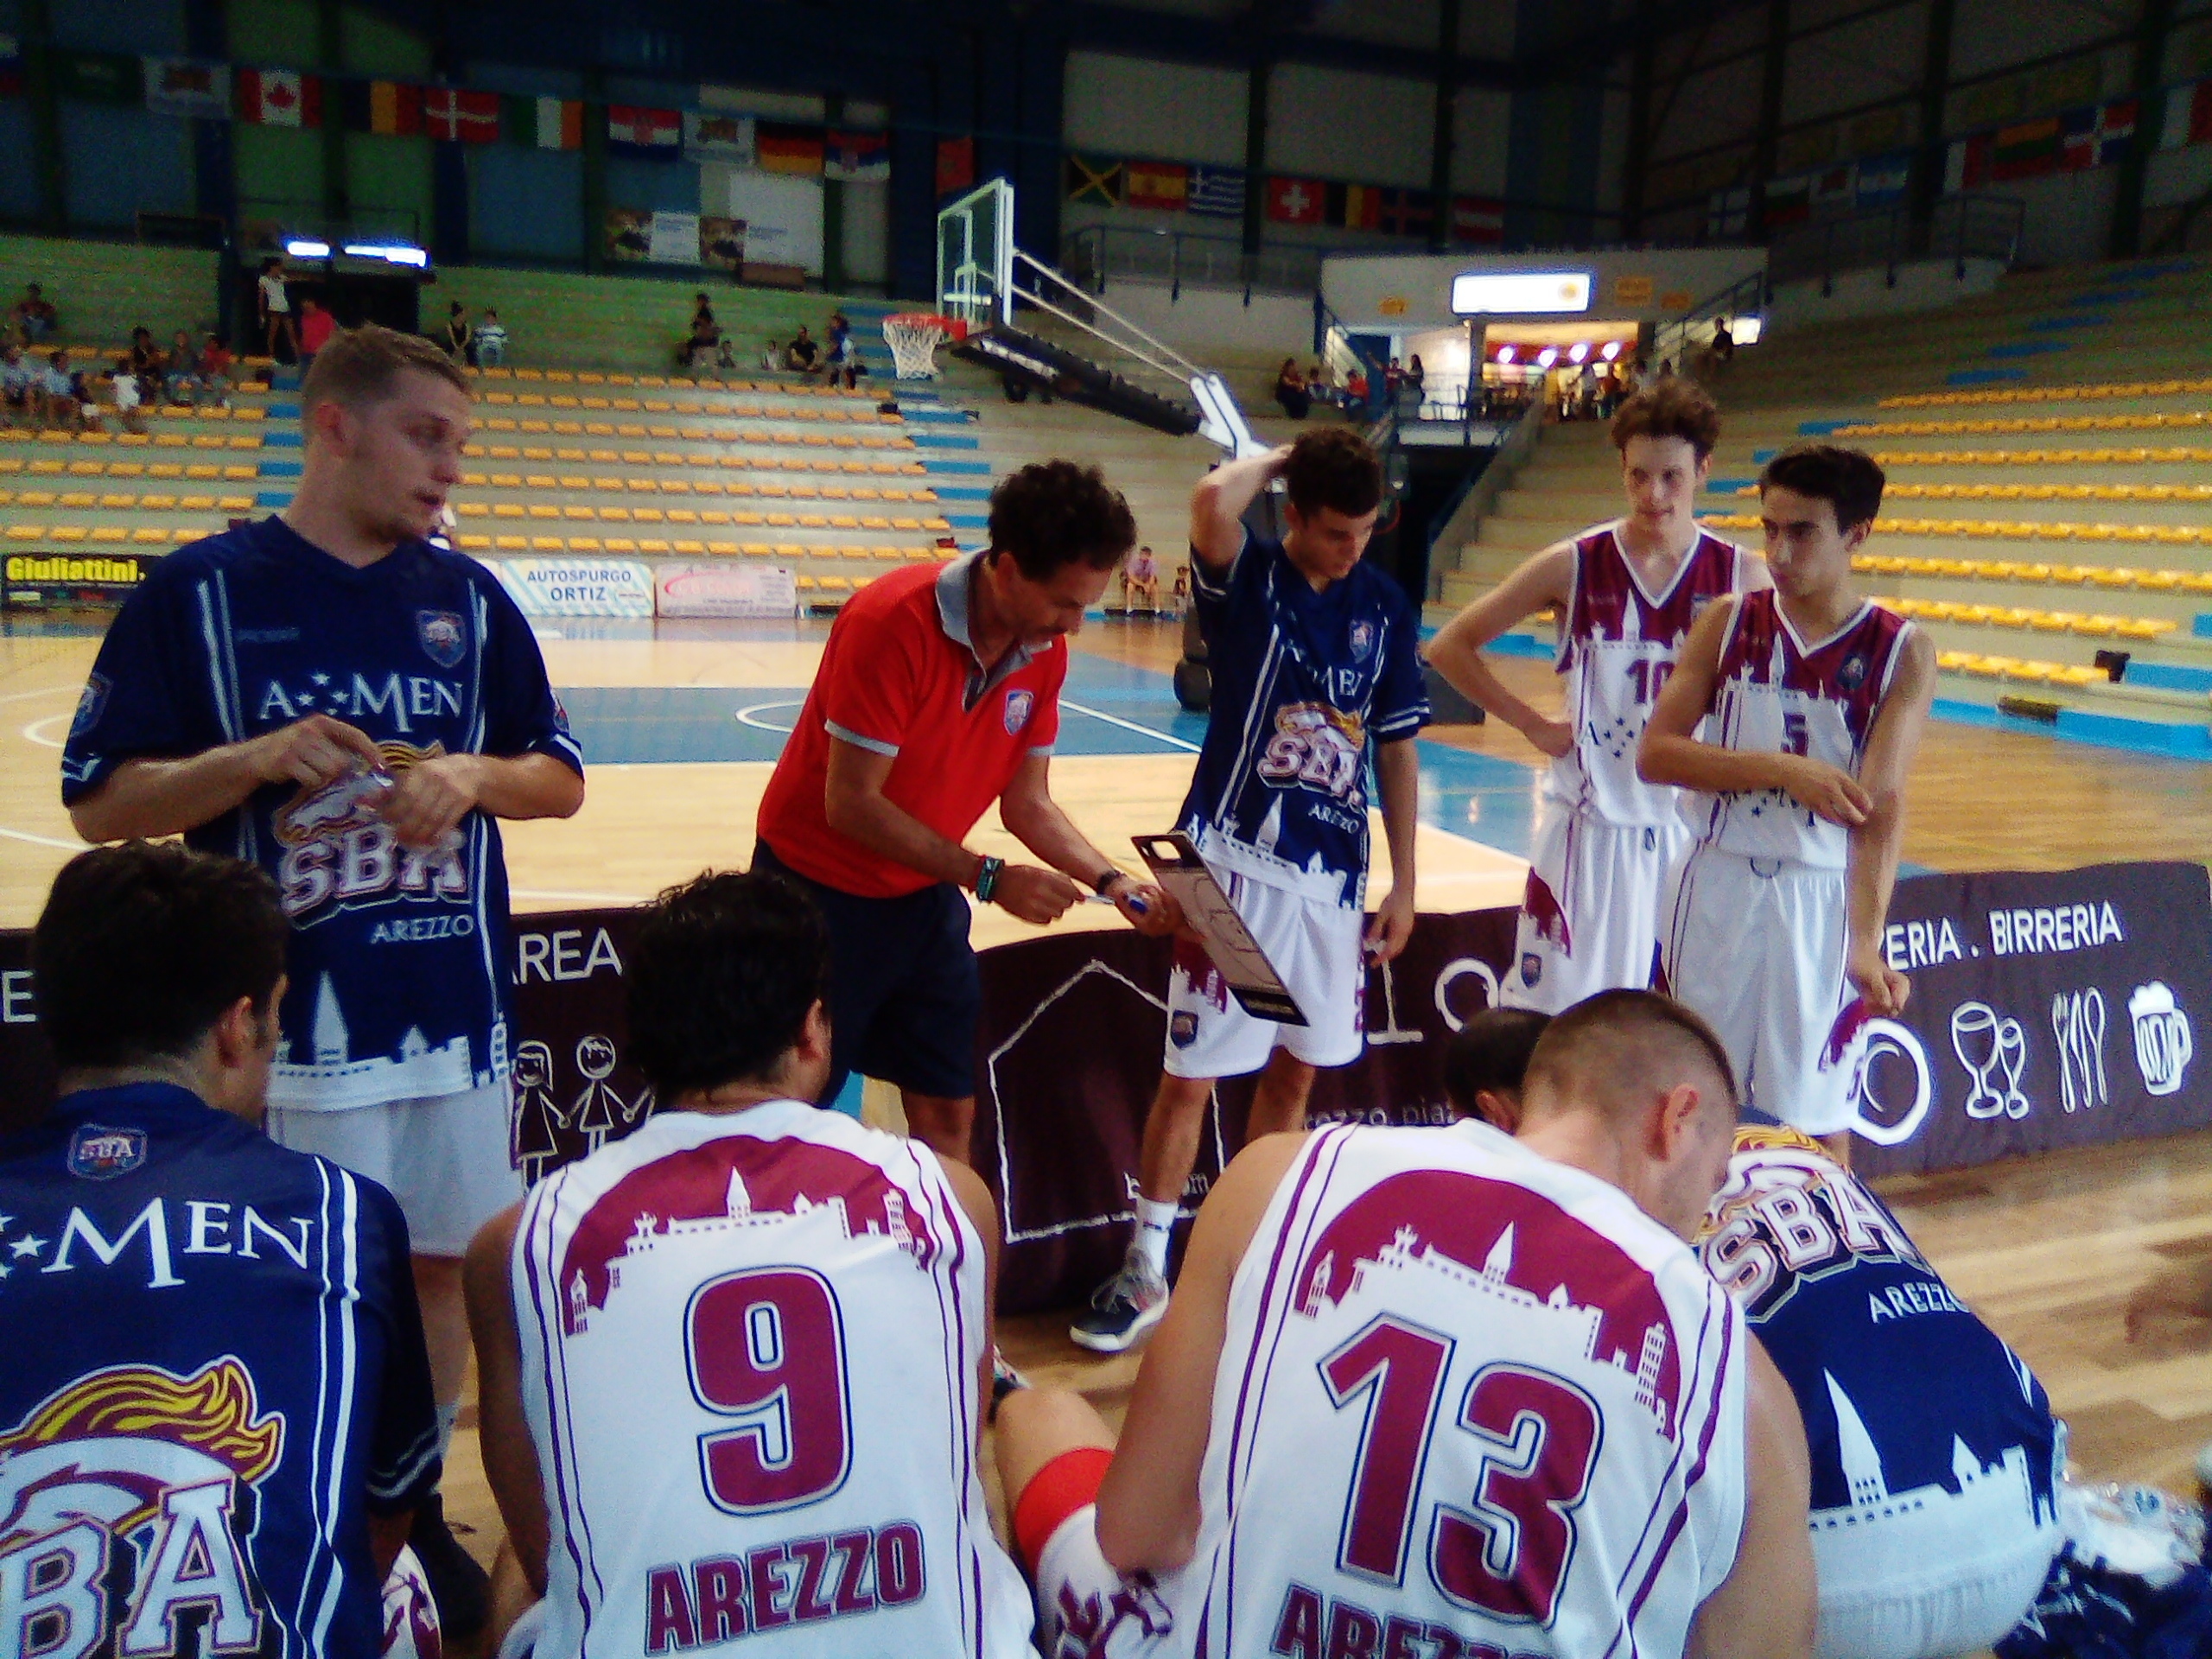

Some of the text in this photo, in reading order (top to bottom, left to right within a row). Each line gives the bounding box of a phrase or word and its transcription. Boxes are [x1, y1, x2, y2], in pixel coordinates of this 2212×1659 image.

[527, 570, 632, 583] AUTOSPURGO
[550, 587, 607, 601] ORTIZ
[371, 914, 474, 944] AREZZO
[512, 926, 623, 985] REA
[1879, 900, 2123, 971] ERIA BIRRERIA
[41, 1197, 315, 1288] MEN
[683, 1264, 854, 1517] 9
[1316, 1311, 1605, 1631] 13
[643, 1519, 927, 1657] AREZZO
